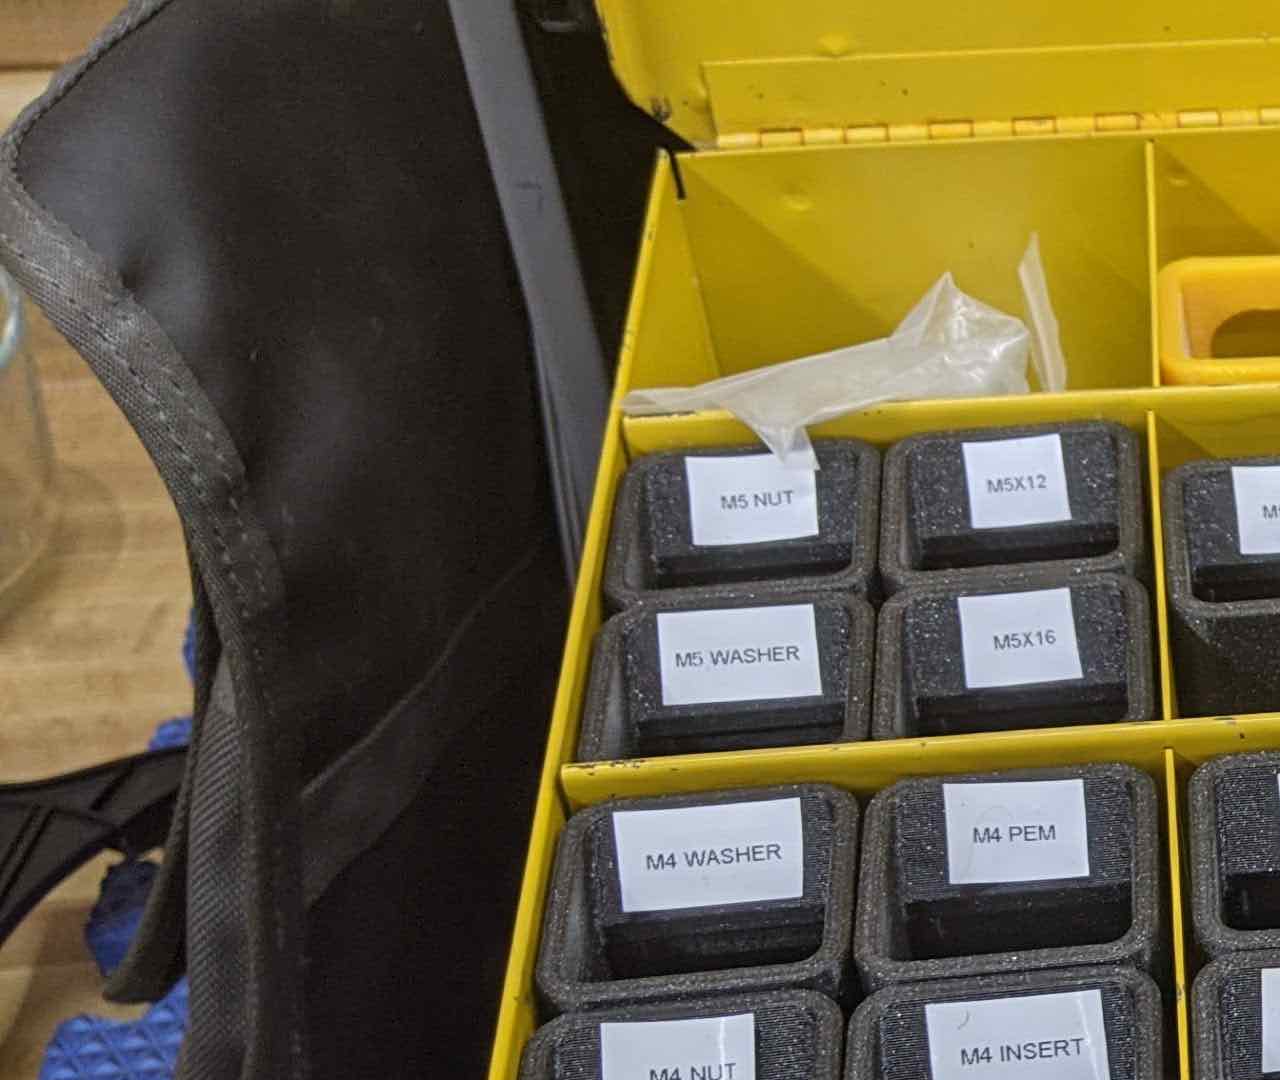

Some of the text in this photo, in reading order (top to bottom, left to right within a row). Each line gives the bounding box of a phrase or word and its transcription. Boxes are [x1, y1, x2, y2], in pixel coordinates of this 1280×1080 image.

[986, 473, 1047, 493] M5X12
[720, 489, 795, 510] M5 NUT
[992, 629, 1057, 651] M5X16
[675, 645, 801, 668] M5 WASHER
[972, 824, 1057, 844] M4 PEM
[645, 843, 782, 871] M4 WASHER
[960, 1037, 1085, 1066] M4 INSERT
